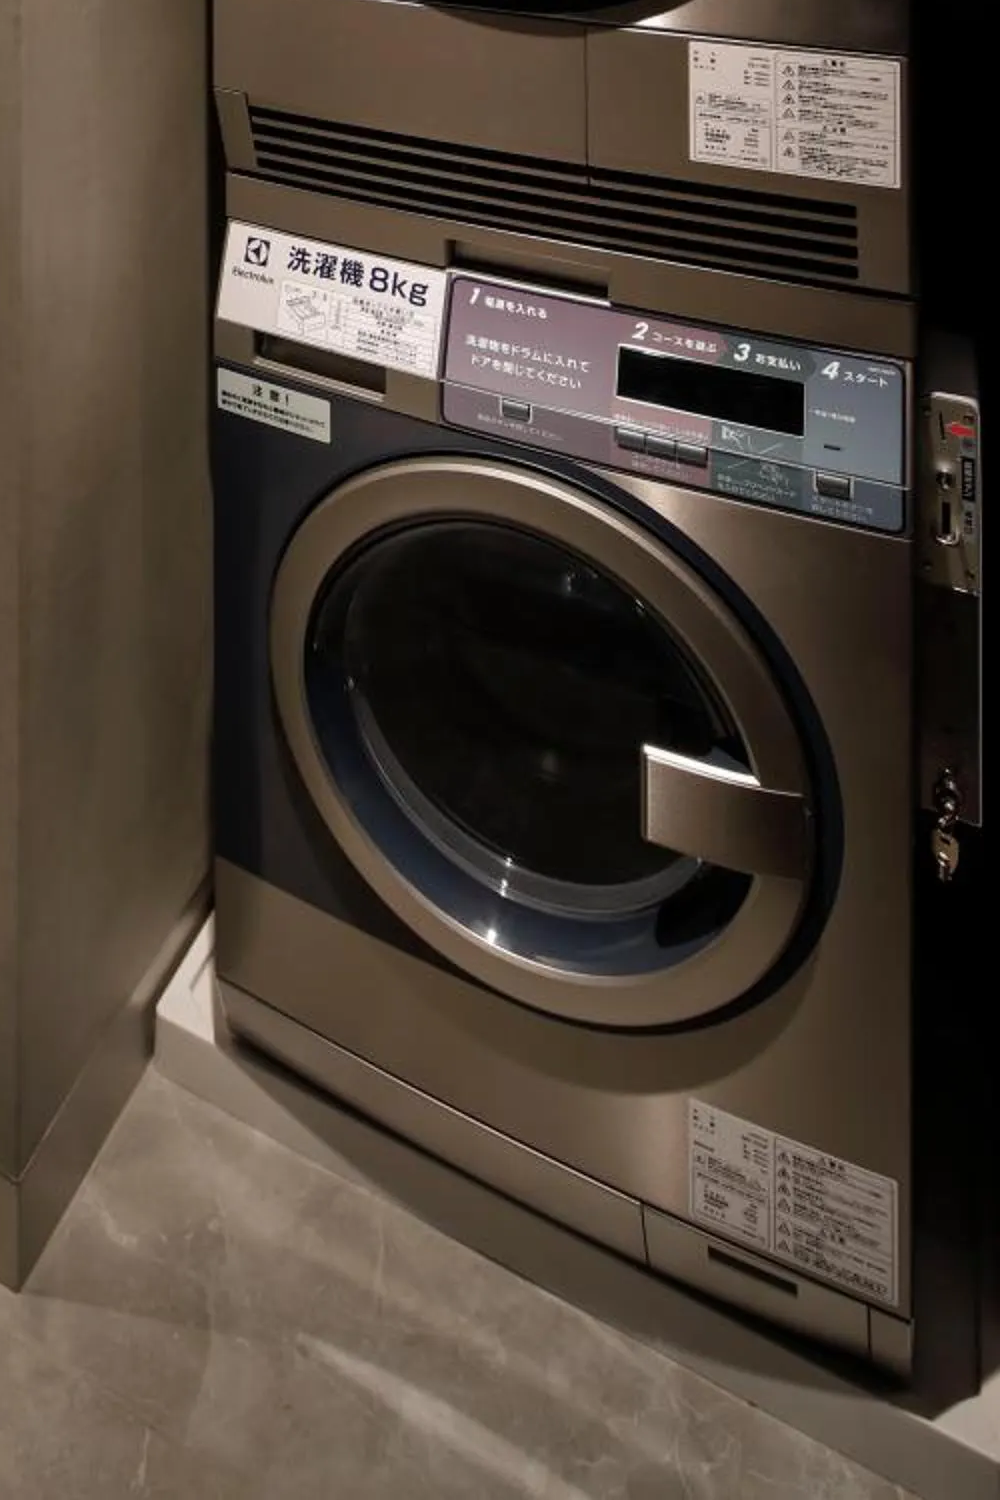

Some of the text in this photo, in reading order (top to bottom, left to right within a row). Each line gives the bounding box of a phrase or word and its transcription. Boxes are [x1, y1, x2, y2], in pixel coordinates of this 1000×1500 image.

[232, 265, 274, 285] Electrolux
[287, 245, 428, 307] 洗濯機8kg
[469, 288, 481, 305] 1
[632, 322, 649, 341] 2
[733, 344, 751, 362] 3
[821, 361, 841, 380] 4
[844, 371, 888, 388] スタート
